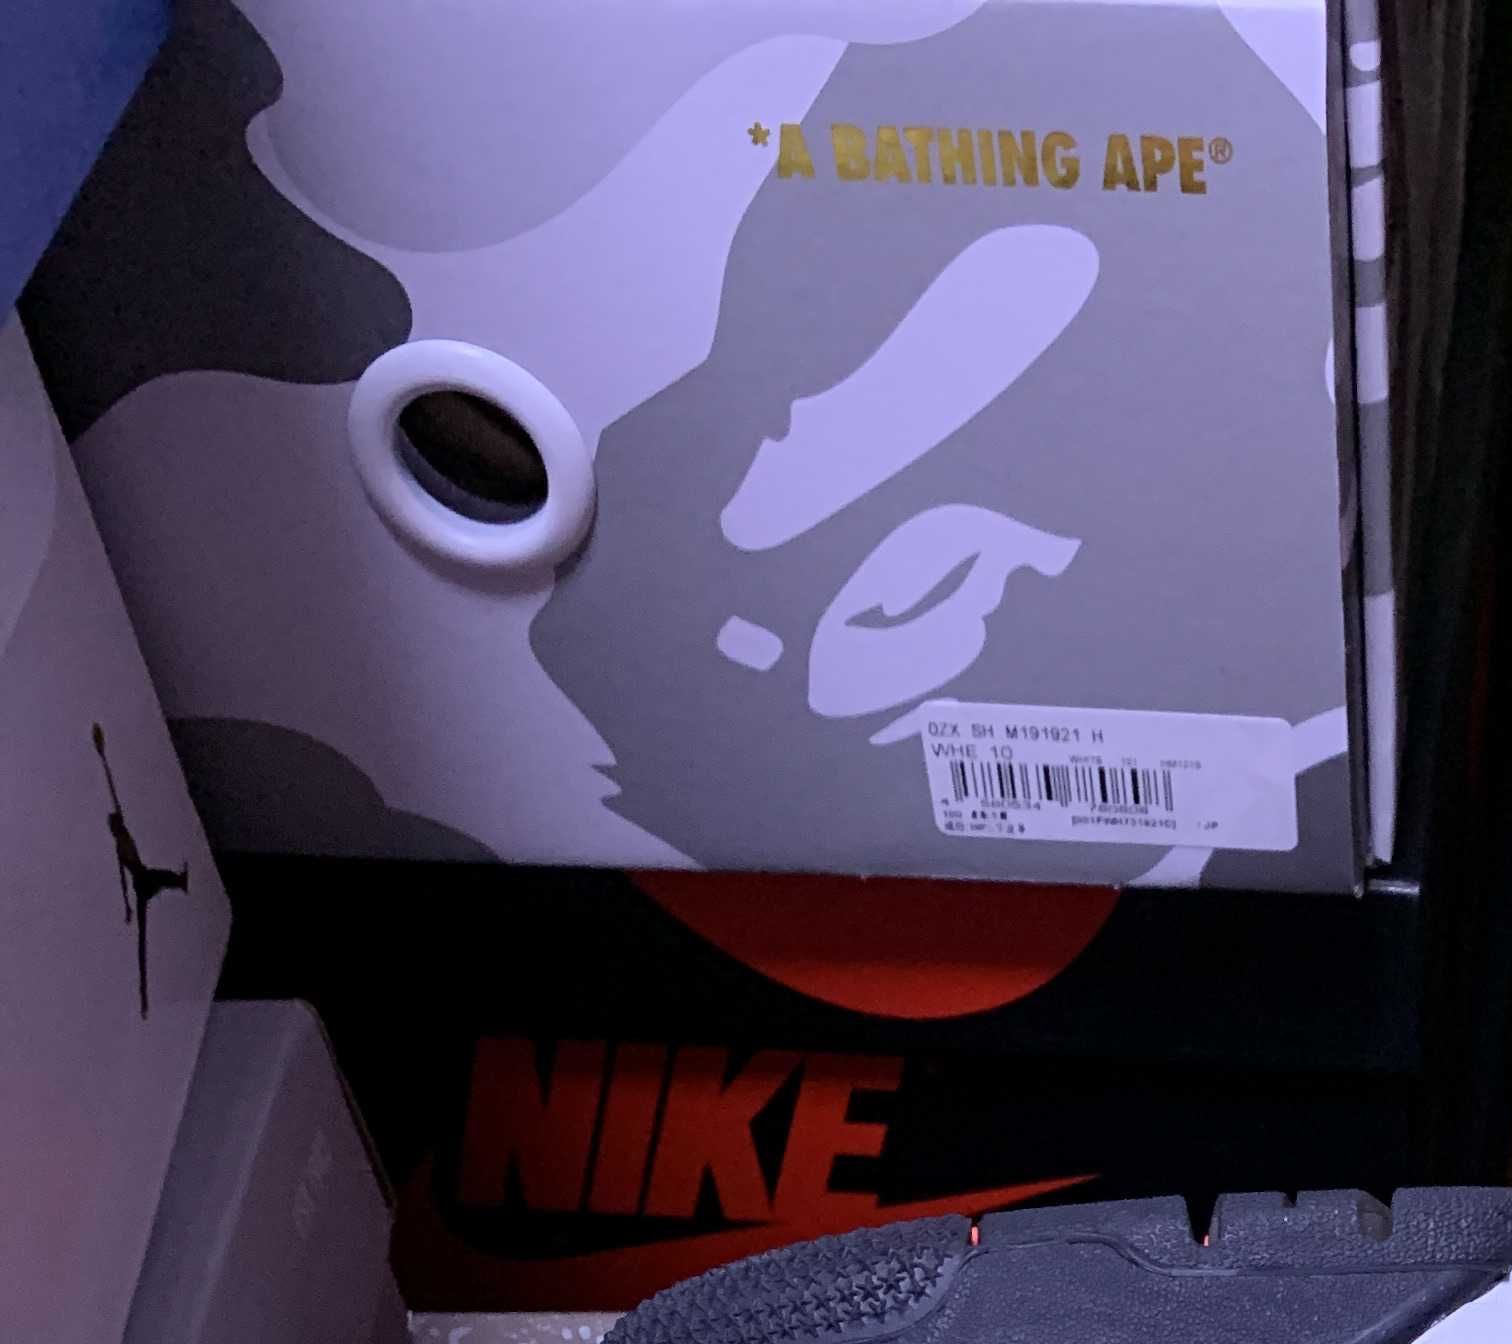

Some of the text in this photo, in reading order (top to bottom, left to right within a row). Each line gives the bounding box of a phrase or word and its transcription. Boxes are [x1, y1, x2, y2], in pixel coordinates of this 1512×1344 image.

[830, 122, 1080, 190] BATHING
[931, 743, 978, 761] WHE
[457, 1036, 904, 1222] NIKE
